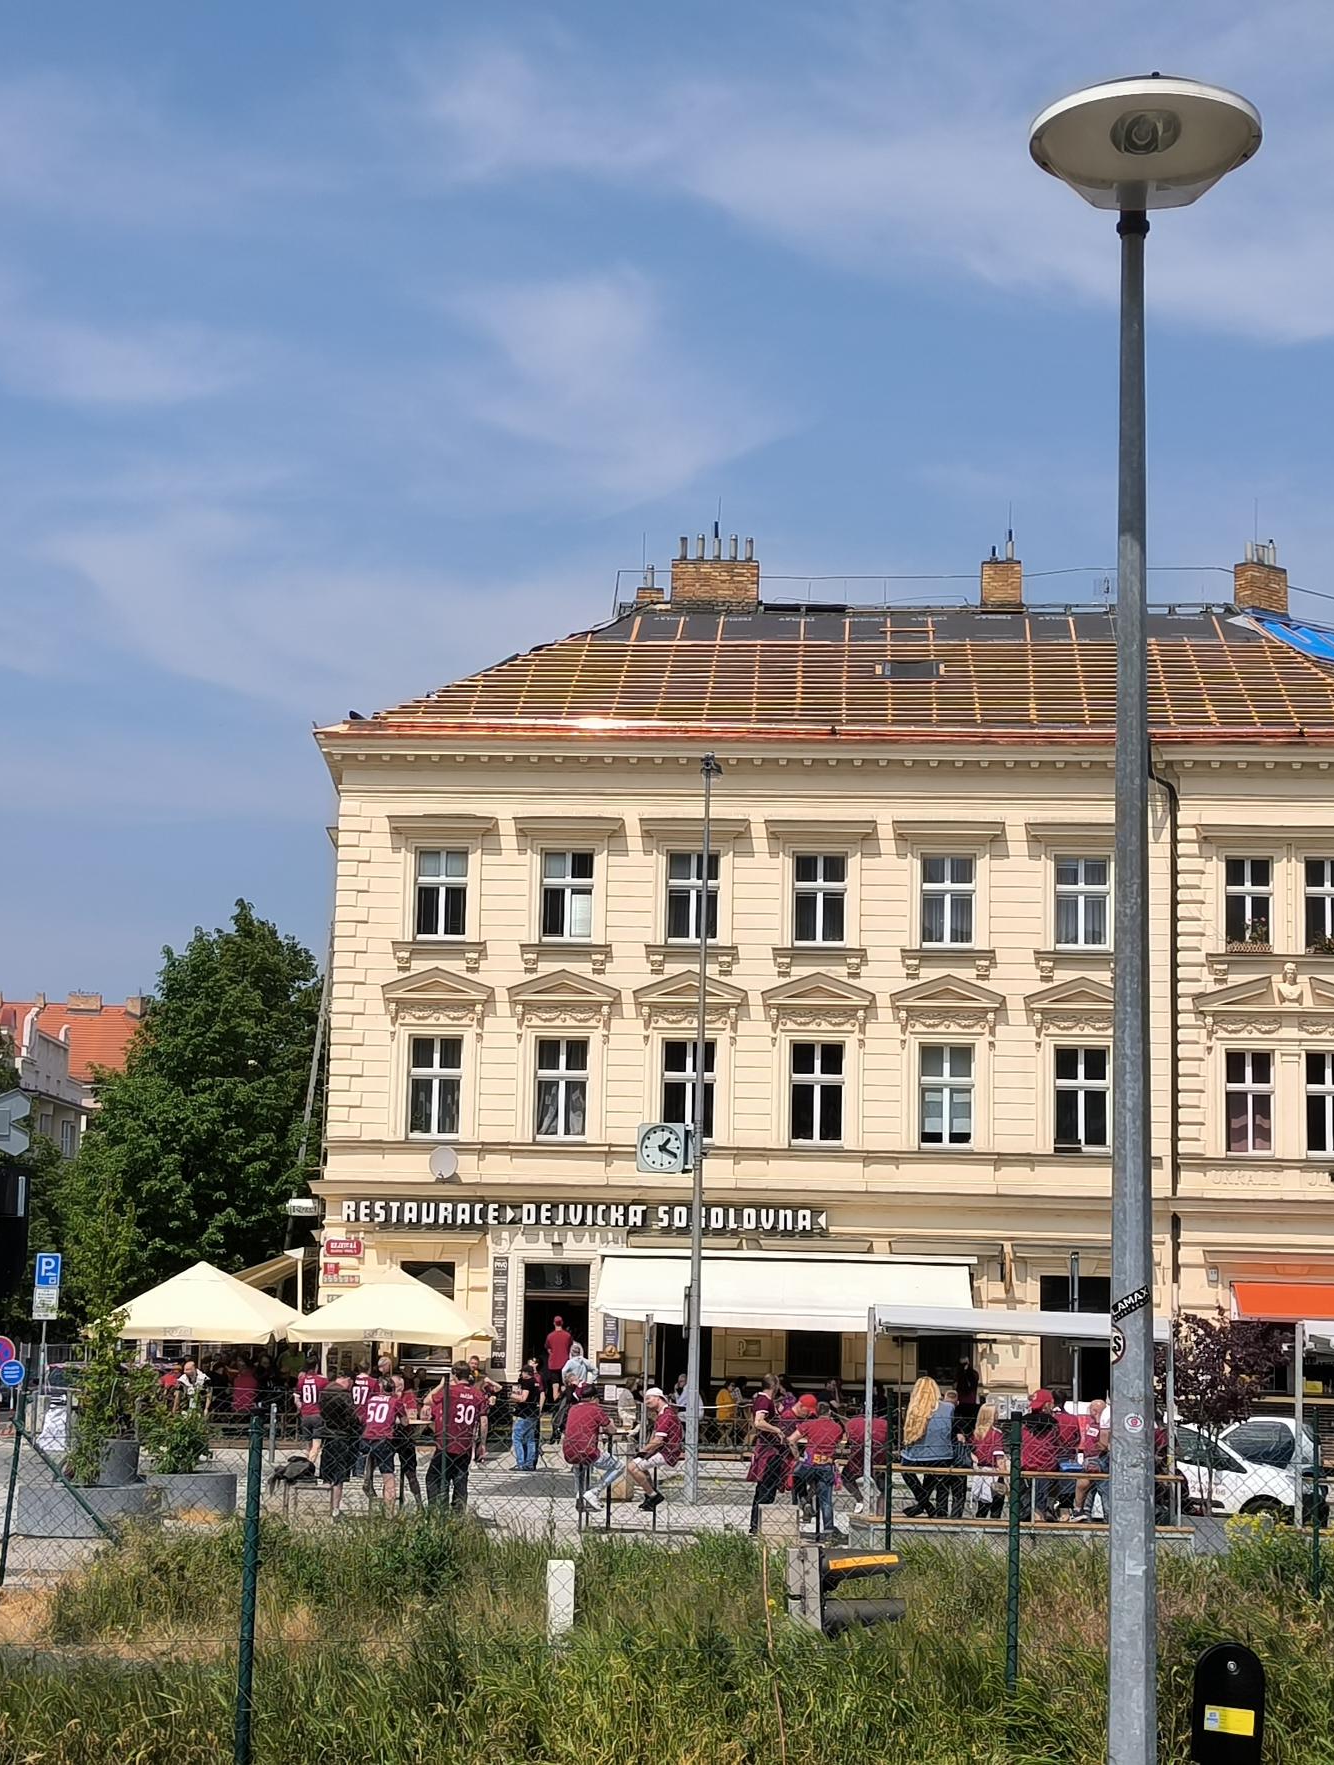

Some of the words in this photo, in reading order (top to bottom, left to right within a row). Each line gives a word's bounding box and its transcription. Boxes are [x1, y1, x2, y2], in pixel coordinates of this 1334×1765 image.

[342, 1200, 499, 1225] RESTAURACE
[41, 1257, 56, 1277] P
[1112, 1286, 1148, 1316] LAMAX
[302, 1385, 317, 1404] 81
[454, 1403, 475, 1425] 30
